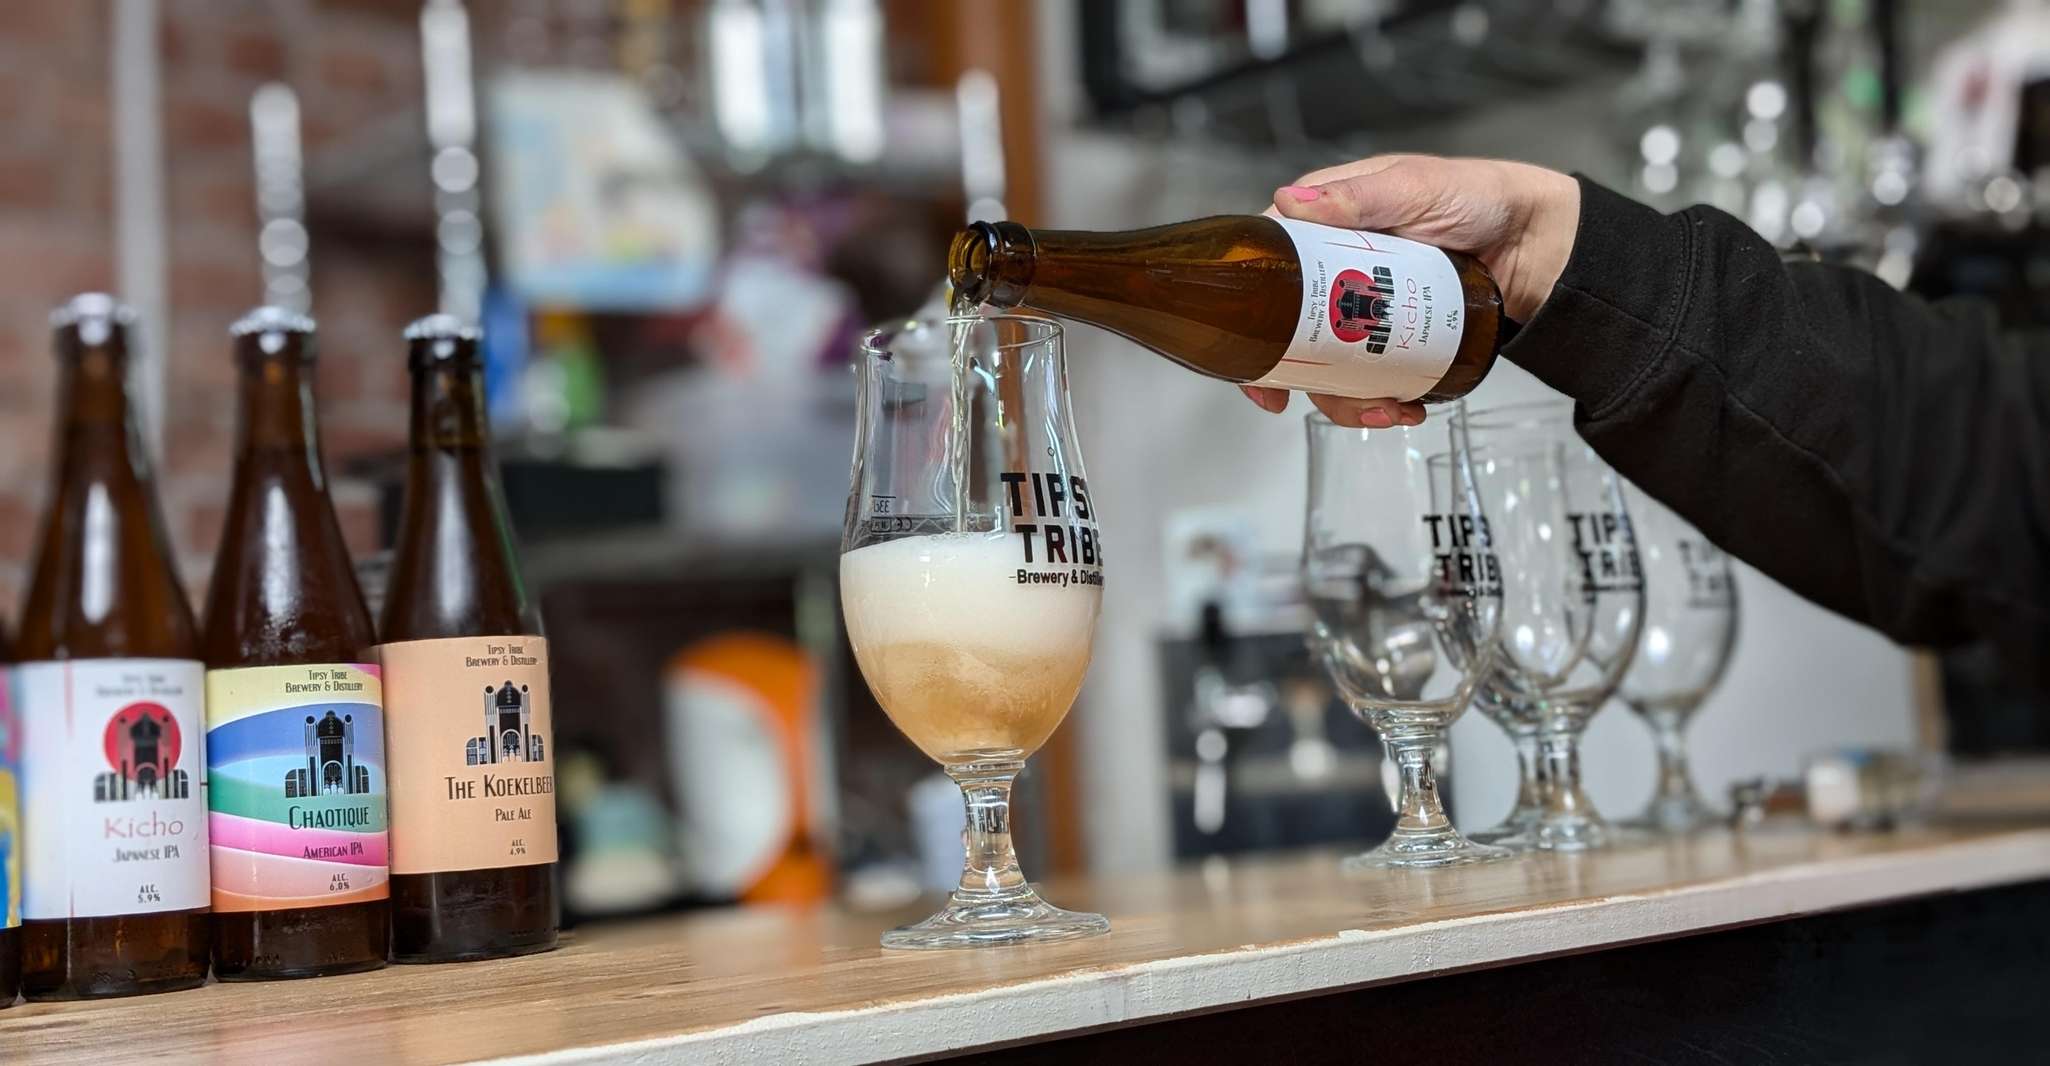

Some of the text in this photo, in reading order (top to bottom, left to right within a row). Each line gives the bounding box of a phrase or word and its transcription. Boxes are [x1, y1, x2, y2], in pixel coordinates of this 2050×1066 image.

[1421, 285, 1431, 302] IPA
[1396, 277, 1417, 350] Kicho
[1071, 569, 1079, 584] &
[104, 811, 184, 839] Kicho
[164, 845, 180, 859] IPA
[350, 842, 364, 855] IPA
[330, 882, 350, 891] 6.0%
[137, 893, 160, 903] 5.9%
